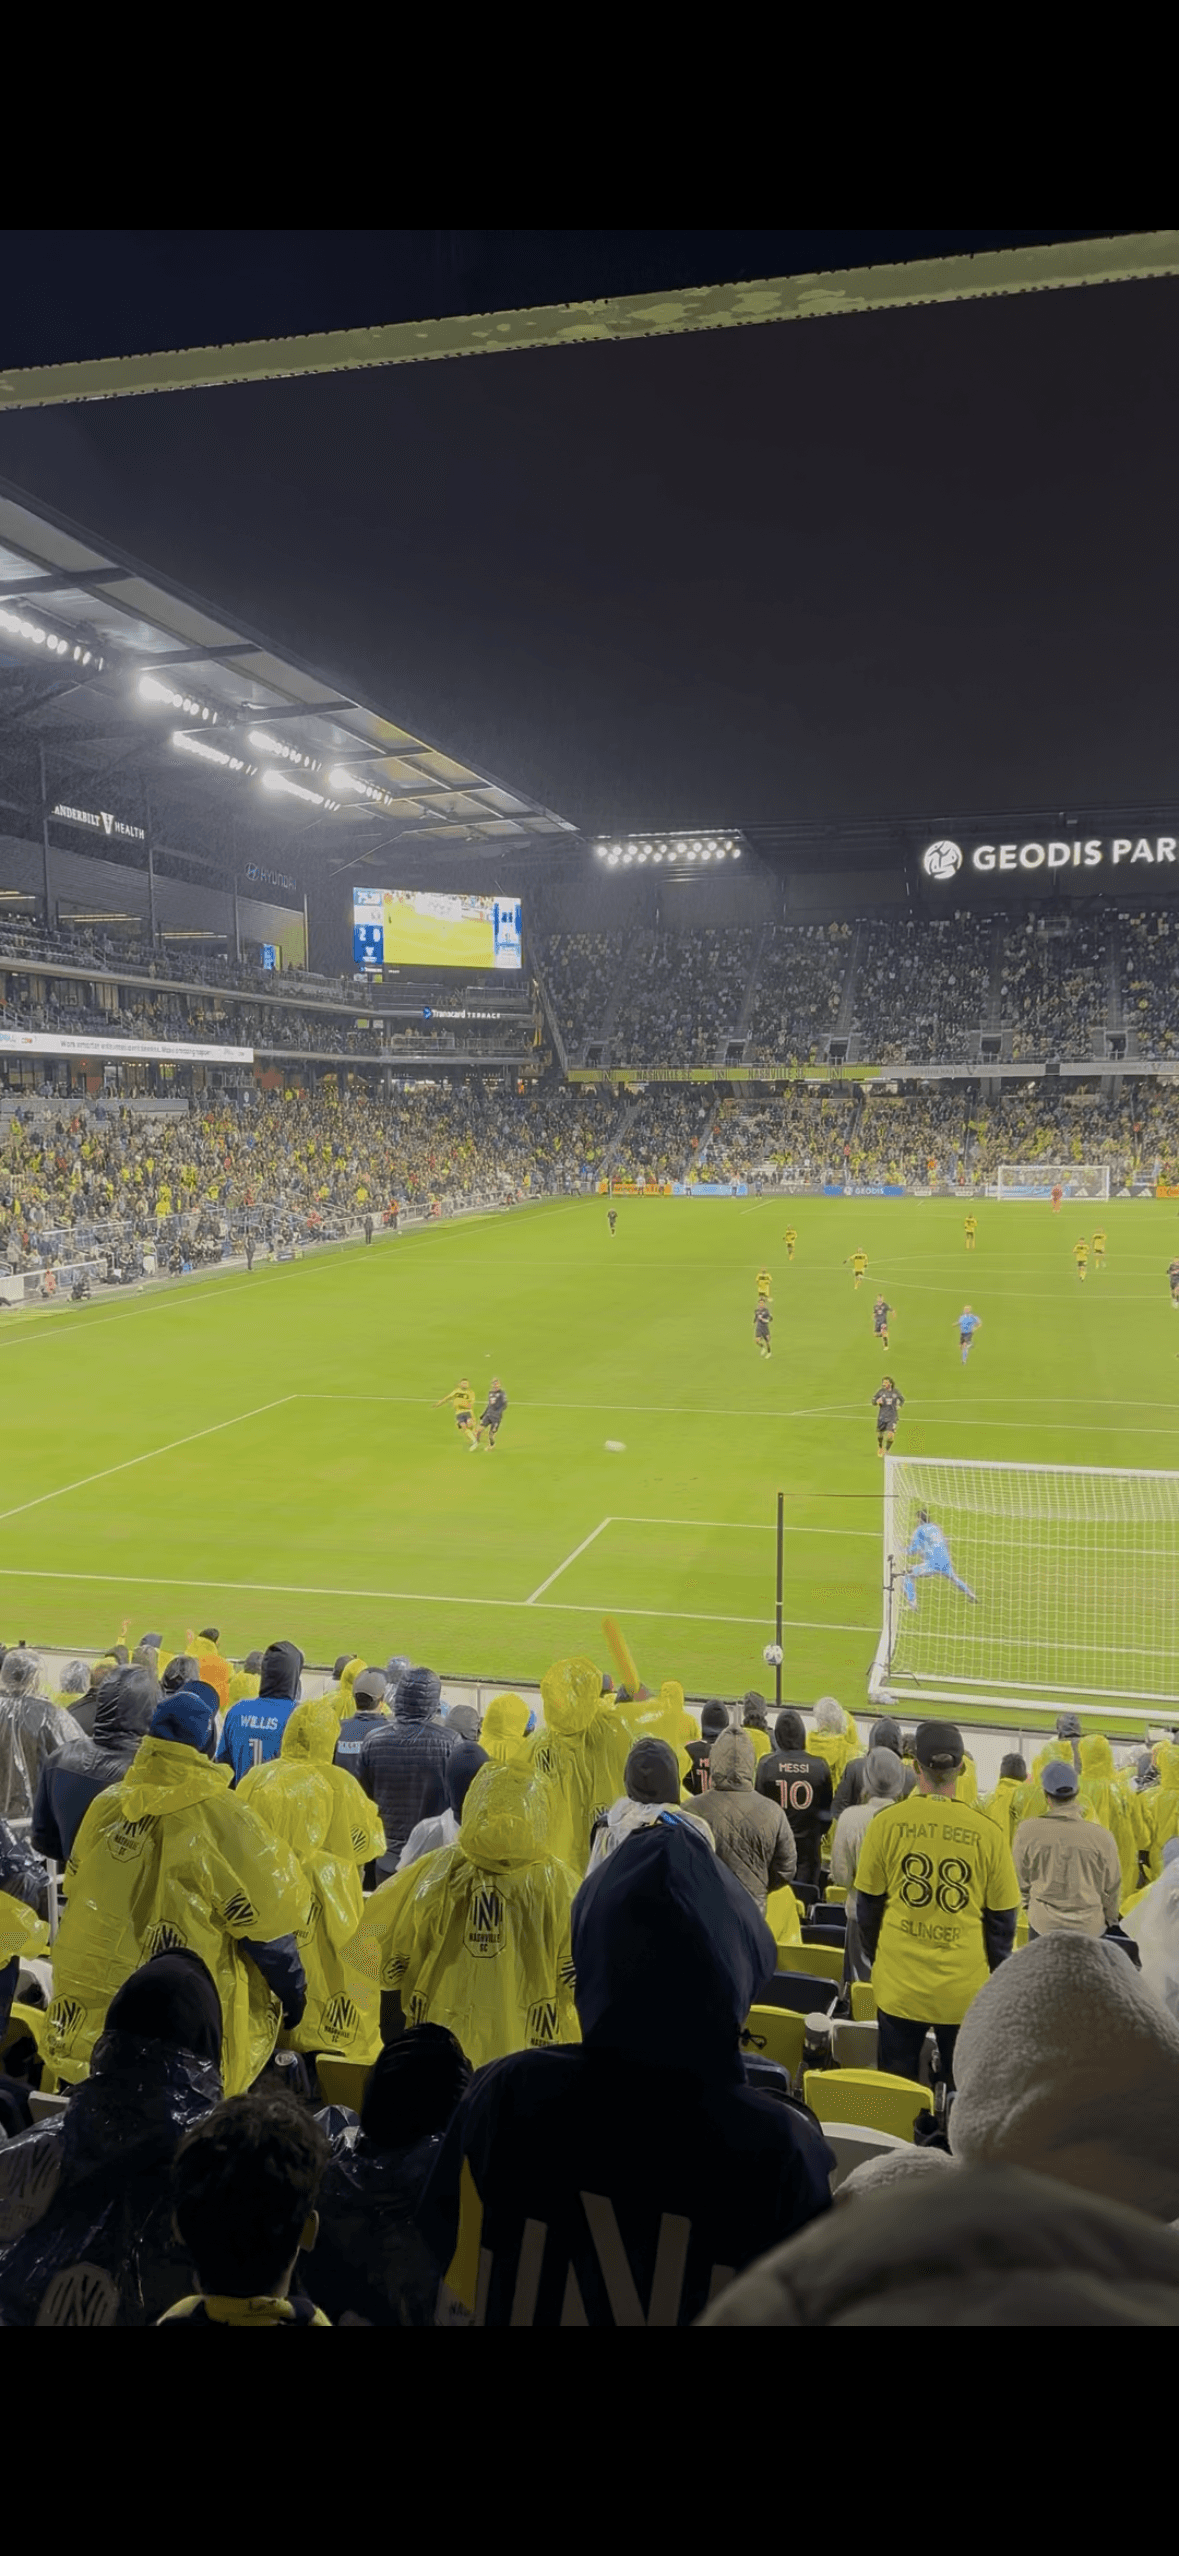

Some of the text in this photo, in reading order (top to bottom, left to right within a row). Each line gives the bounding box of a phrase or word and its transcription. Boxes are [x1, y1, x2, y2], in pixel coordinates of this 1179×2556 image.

[51, 804, 100, 827] ANDERBILT
[114, 821, 145, 840] HEALTH
[973, 840, 1102, 870] GEODIS
[359, 927, 381, 942] 2 0
[855, 1186, 884, 1196] GEODIS
[240, 1714, 279, 1730] WILLIS
[248, 1738, 263, 1766] 1
[778, 1763, 810, 1774] MESSI
[775, 1780, 814, 1811] 10
[898, 1822, 982, 1847] THAT BEER
[900, 1851, 972, 1914] 88
[900, 1919, 962, 1943] SLINGER
